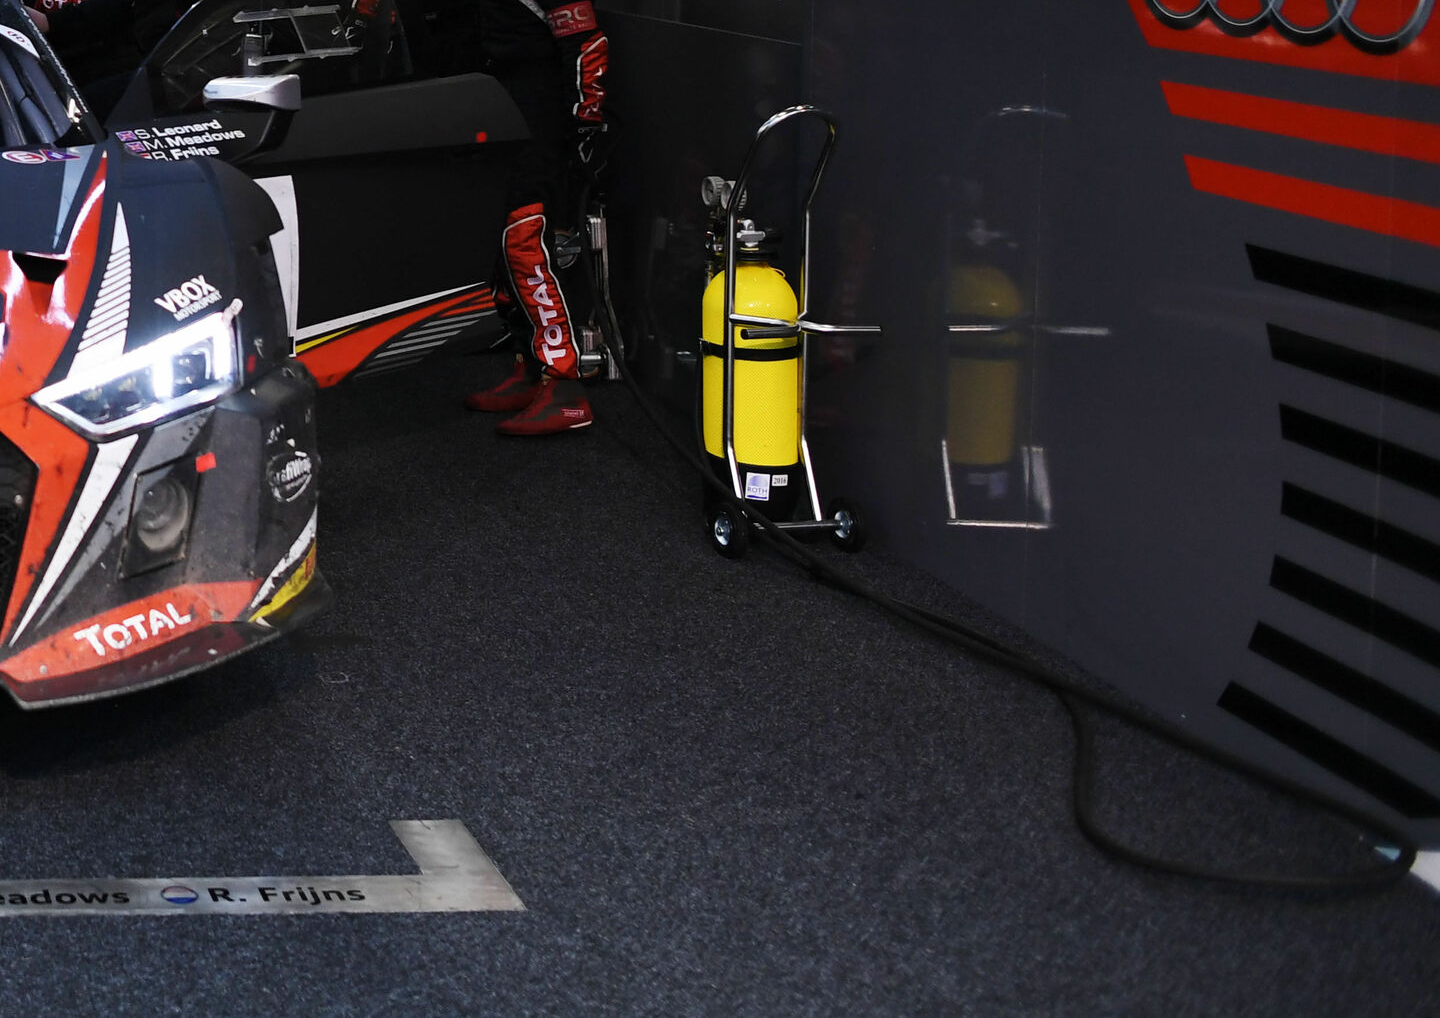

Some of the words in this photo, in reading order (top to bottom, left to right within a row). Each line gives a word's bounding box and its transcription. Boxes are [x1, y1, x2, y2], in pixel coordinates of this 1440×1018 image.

[136, 129, 155, 140] S.
[152, 119, 222, 137] Leonard
[144, 139, 168, 151] M.
[167, 130, 246, 148] Meadows
[154, 275, 217, 313] VBOX
[526, 264, 567, 366] TOTAL
[747, 486, 768, 495] ROTH
[73, 602, 192, 657] TOTAL
[208, 887, 248, 903] R.
[258, 885, 366, 905] Frijns
